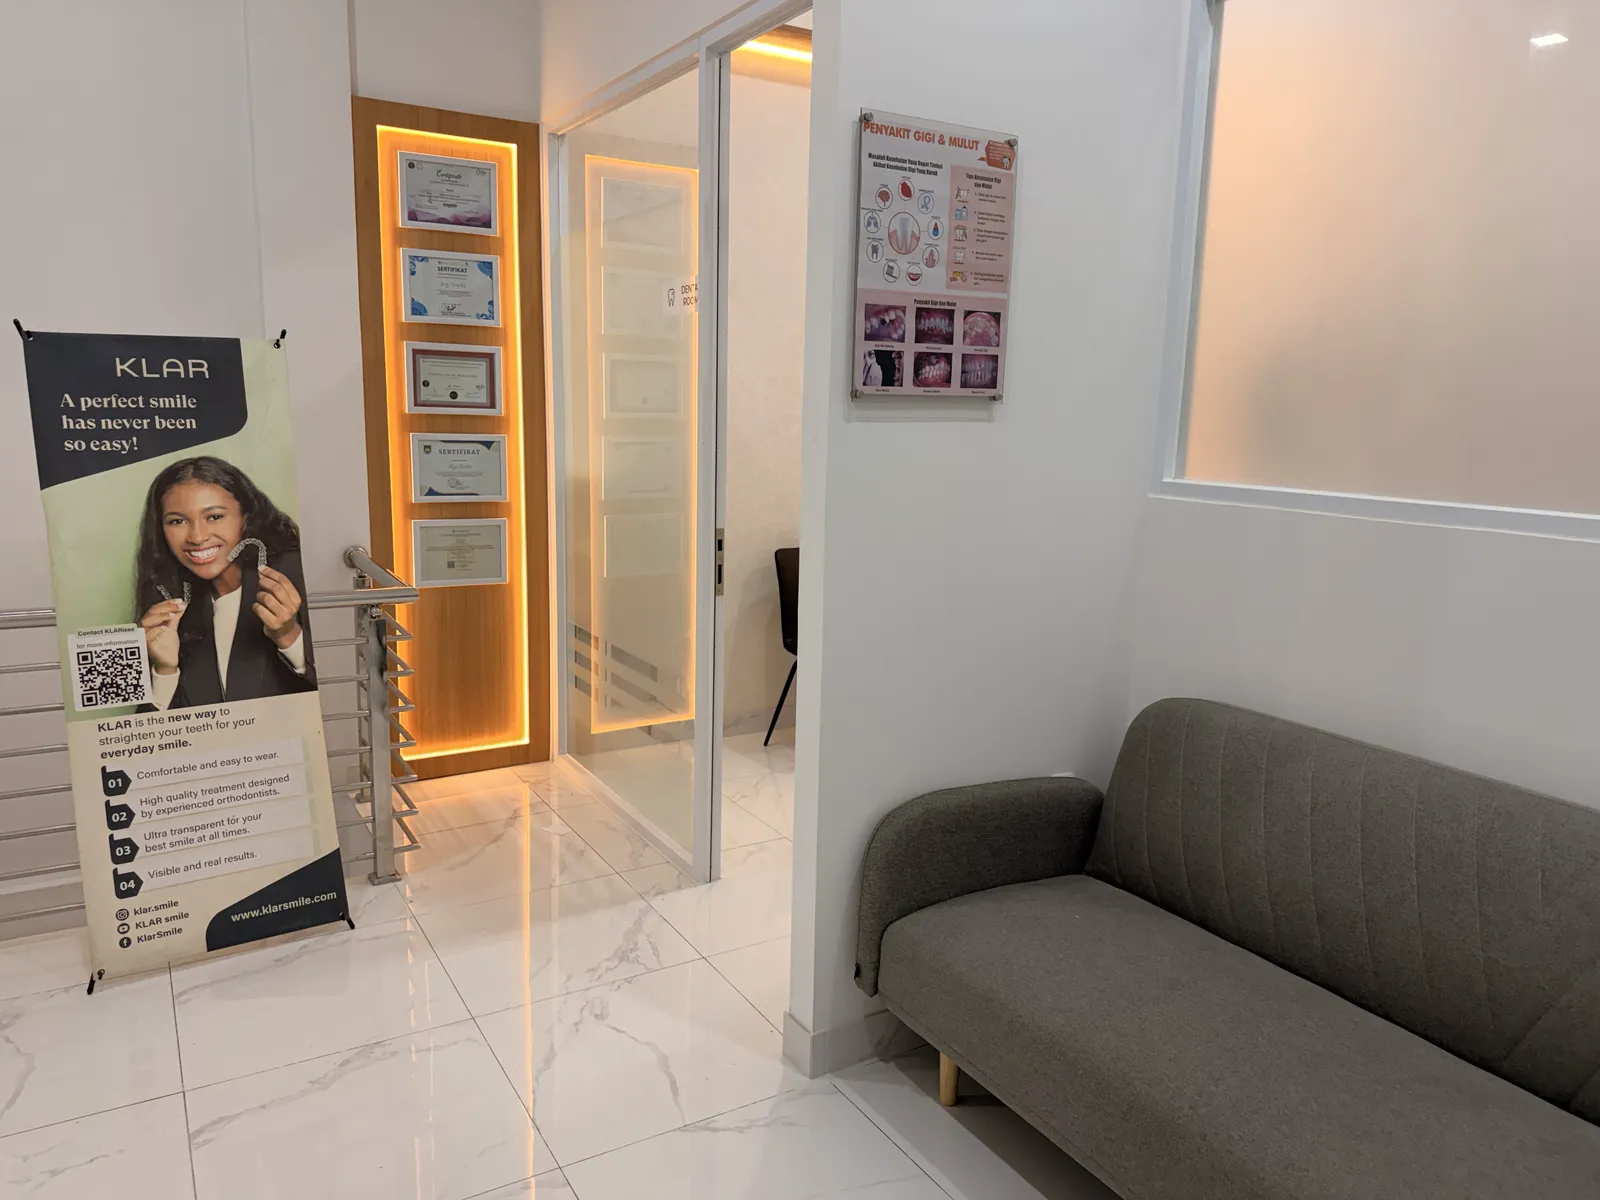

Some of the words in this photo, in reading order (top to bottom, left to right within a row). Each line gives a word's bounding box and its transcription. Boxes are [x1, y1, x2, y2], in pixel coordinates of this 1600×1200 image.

[863, 122, 911, 139] PENYAKIT
[914, 130, 935, 143] GIGI
[938, 134, 946, 145] &
[949, 136, 979, 151] MULUT
[886, 155, 907, 164] Kesehatan
[887, 163, 907, 172] Kesehatan
[681, 283, 698, 294] DENTA
[115, 357, 209, 378] KLAR
[60, 393, 75, 408] A
[80, 394, 145, 411] perfect
[150, 394, 197, 409] smile
[61, 415, 96, 430] has
[101, 418, 150, 430] never
[155, 416, 197, 430] been
[64, 439, 86, 451] so
[90, 437, 138, 454] easy!
[98, 720, 132, 732] KLAR
[135, 717, 144, 728] is
[147, 715, 165, 726] the
[168, 712, 192, 723] new
[194, 709, 217, 722] way
[219, 707, 230, 716] to
[99, 729, 156, 746] straighten
[158, 728, 183, 740] your
[185, 722, 213, 734] teeth
[215, 719, 230, 730] for
[232, 716, 256, 730] your
[100, 744, 155, 760] everyday
[157, 739, 192, 751] smile.
[136, 763, 198, 780] Comfortable
[199, 759, 218, 770] and
[220, 756, 241, 768] easy
[243, 754, 253, 763] to
[255, 751, 279, 761] wear.
[108, 778, 123, 789] 01
[140, 794, 164, 807] High
[166, 789, 199, 803] quality
[201, 782, 246, 797] treatment
[247, 774, 290, 789] designed
[141, 807, 153, 819] by
[156, 800, 214, 816] experienced
[216, 788, 280, 805] orthodontists.
[111, 812, 127, 823] 02
[143, 829, 168, 841] Ultra
[170, 819, 225, 838] transparent
[227, 815, 239, 825] for
[242, 812, 262, 827] your
[145, 842, 167, 853] best
[169, 837, 195, 849] smile
[197, 834, 207, 843] at
[209, 831, 220, 841] all
[222, 827, 250, 838] times.
[115, 846, 131, 857] 03
[148, 866, 181, 879] Visible
[183, 861, 202, 872] and
[204, 857, 222, 867] real
[224, 852, 257, 864] results.
[120, 880, 136, 891] 04
[133, 900, 179, 916] klar.smile
[231, 891, 337, 922] www.klarsmile.com
[135, 918, 162, 930] KLAR
[164, 911, 189, 924] smile
[137, 926, 183, 944] KlarSmile
